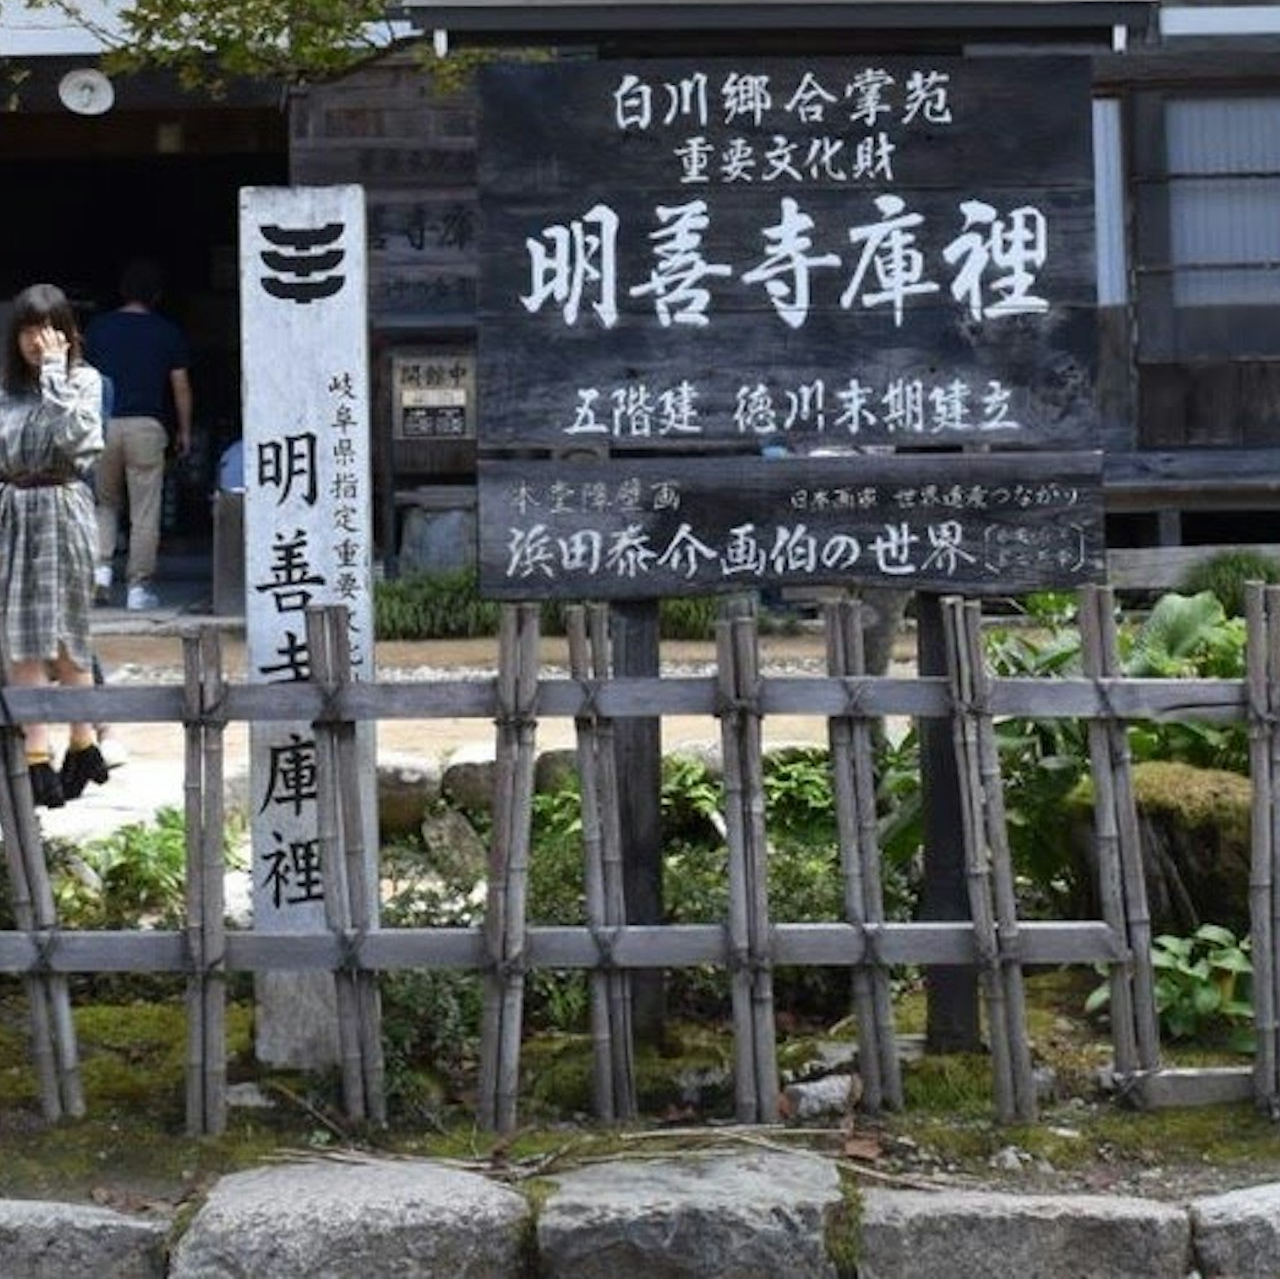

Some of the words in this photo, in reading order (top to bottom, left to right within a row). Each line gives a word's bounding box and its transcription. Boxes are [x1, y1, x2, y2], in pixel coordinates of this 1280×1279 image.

[614, 68, 952, 129] 白川郷合掌苑
[674, 132, 895, 183] 重要文化財
[520, 194, 1049, 328] 明善寺庫裡
[564, 380, 702, 437] 五階建
[329, 372, 363, 683] 岐阜県指定重要
